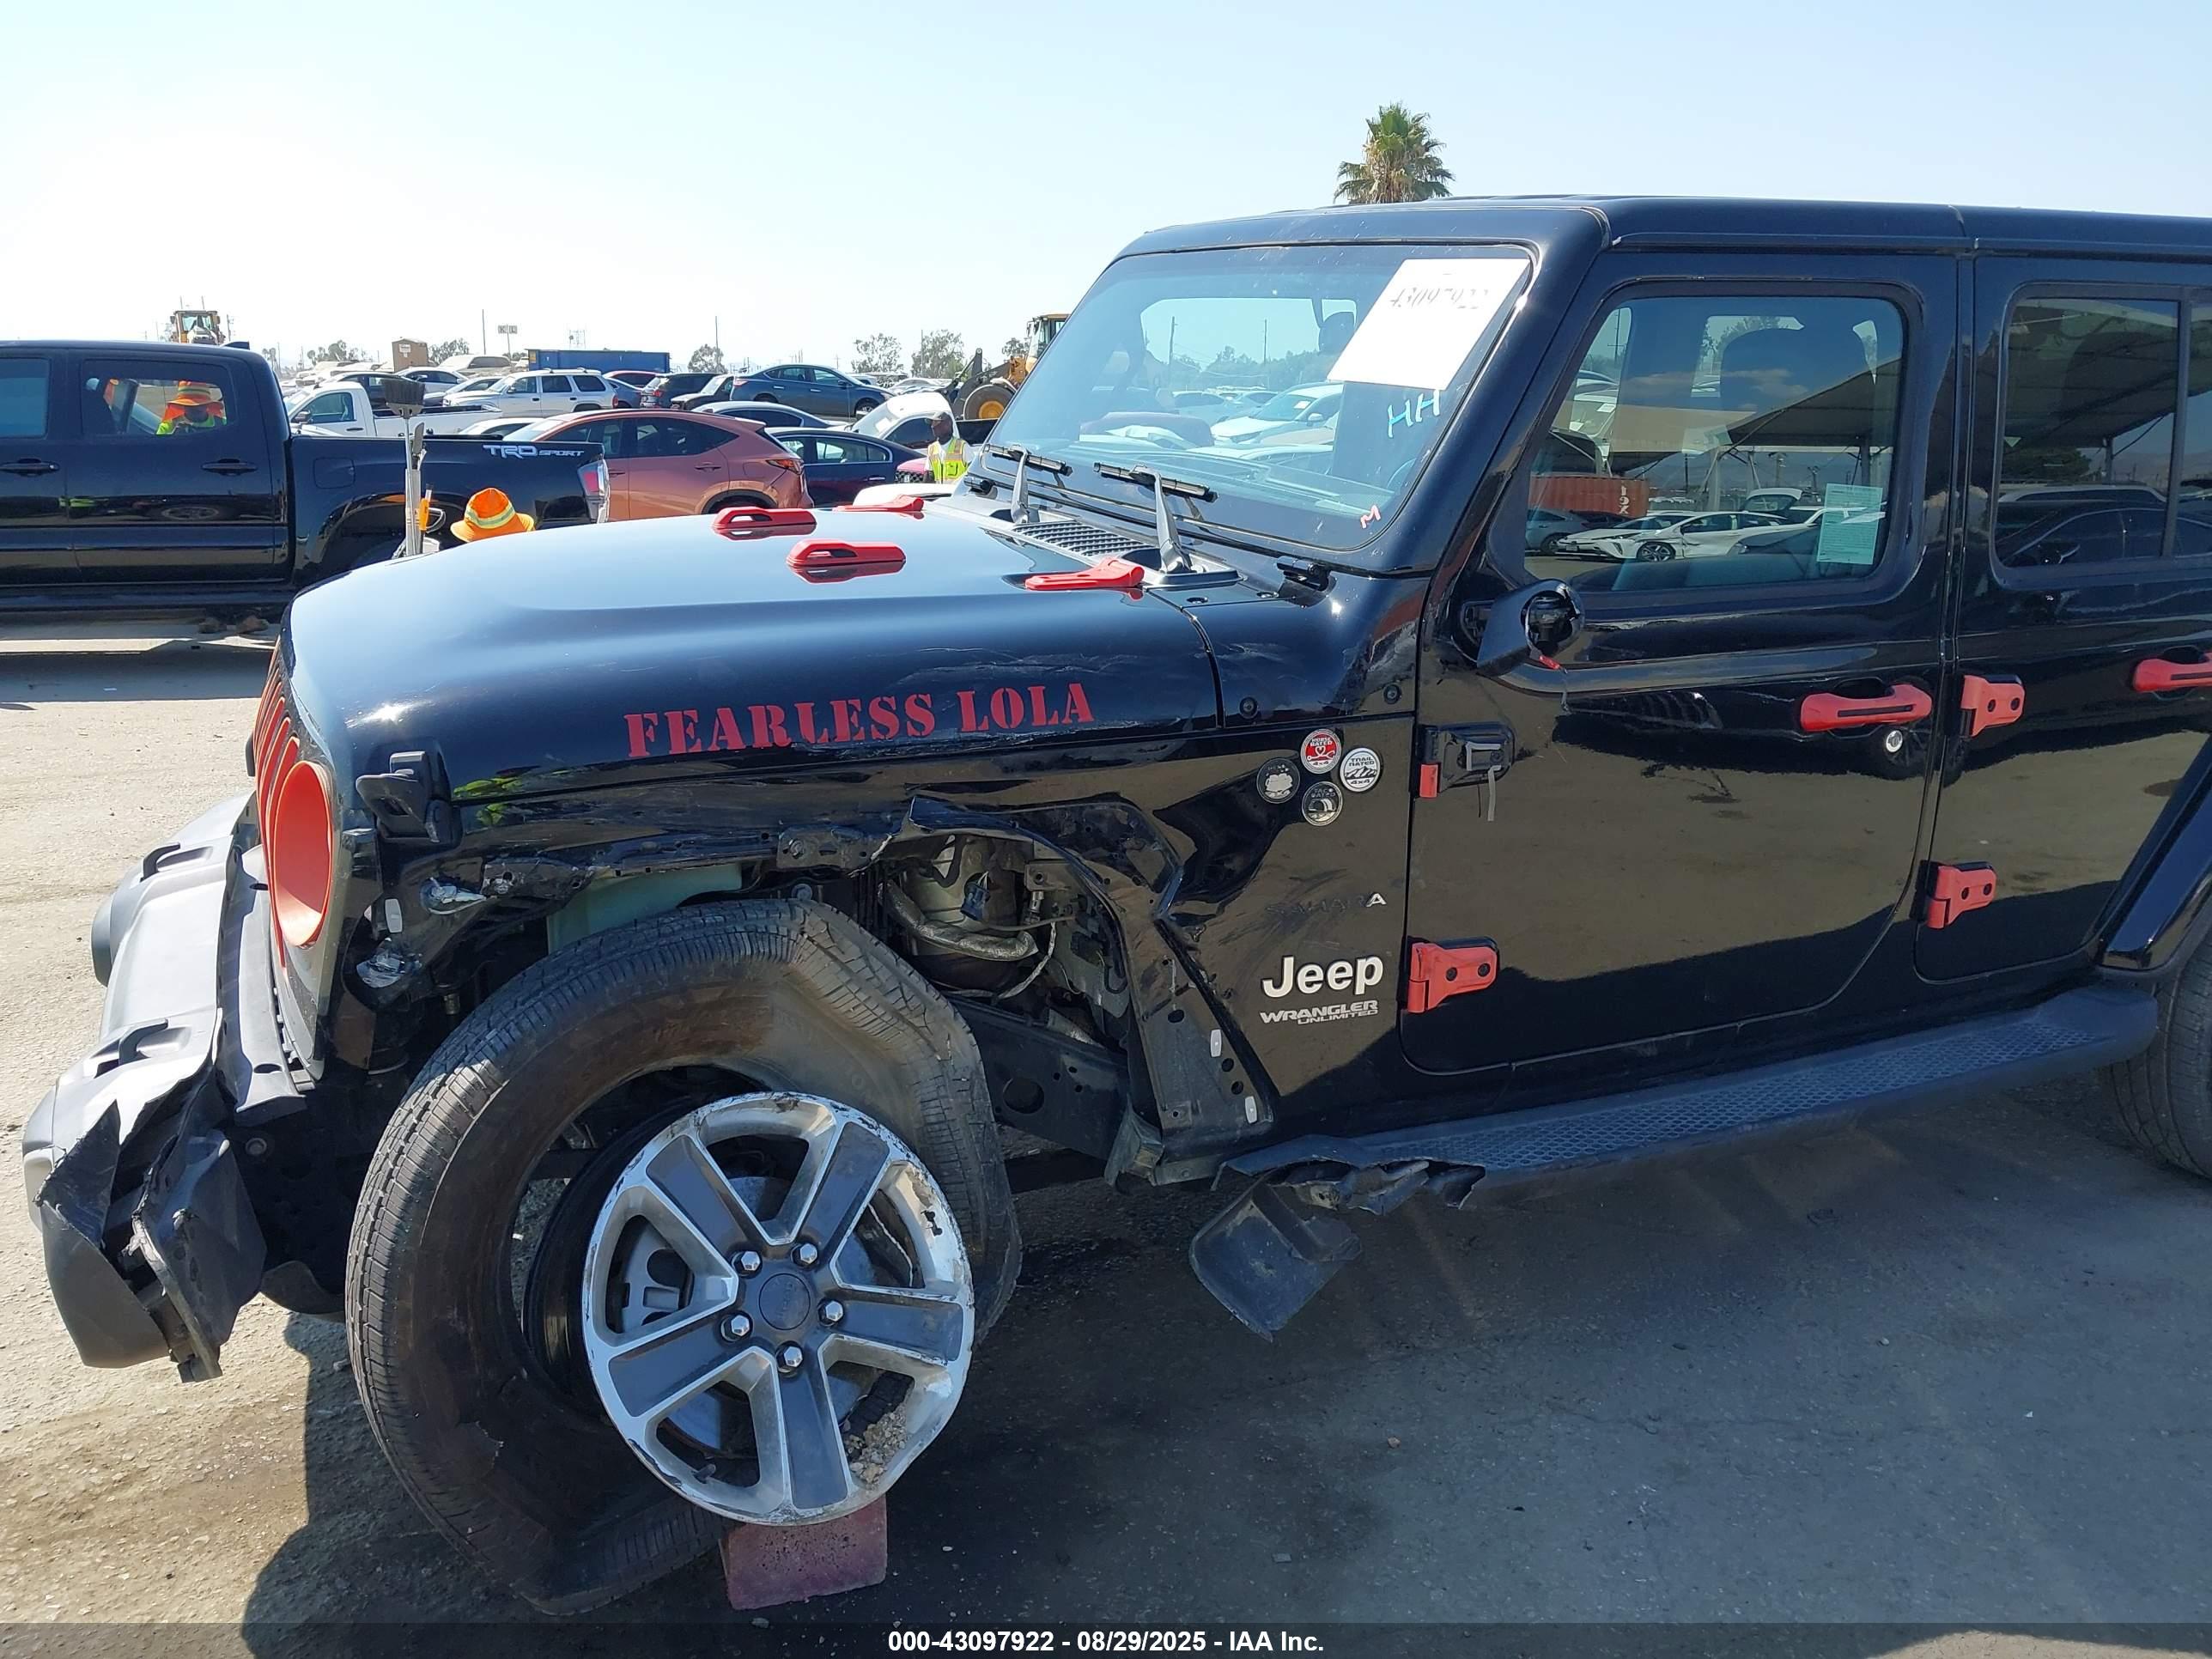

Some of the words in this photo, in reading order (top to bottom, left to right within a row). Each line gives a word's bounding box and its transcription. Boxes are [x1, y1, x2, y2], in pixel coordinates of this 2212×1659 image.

[1387, 389, 1440, 438] HH
[483, 444, 538, 459] TRD
[623, 692, 936, 758] FEARLESS
[956, 682, 1095, 733] LOLA
[1262, 955, 1383, 998] Jeep
[1260, 1000, 1379, 1024] WRANGLER
[1297, 1009, 1378, 1025] UNLIMITED
